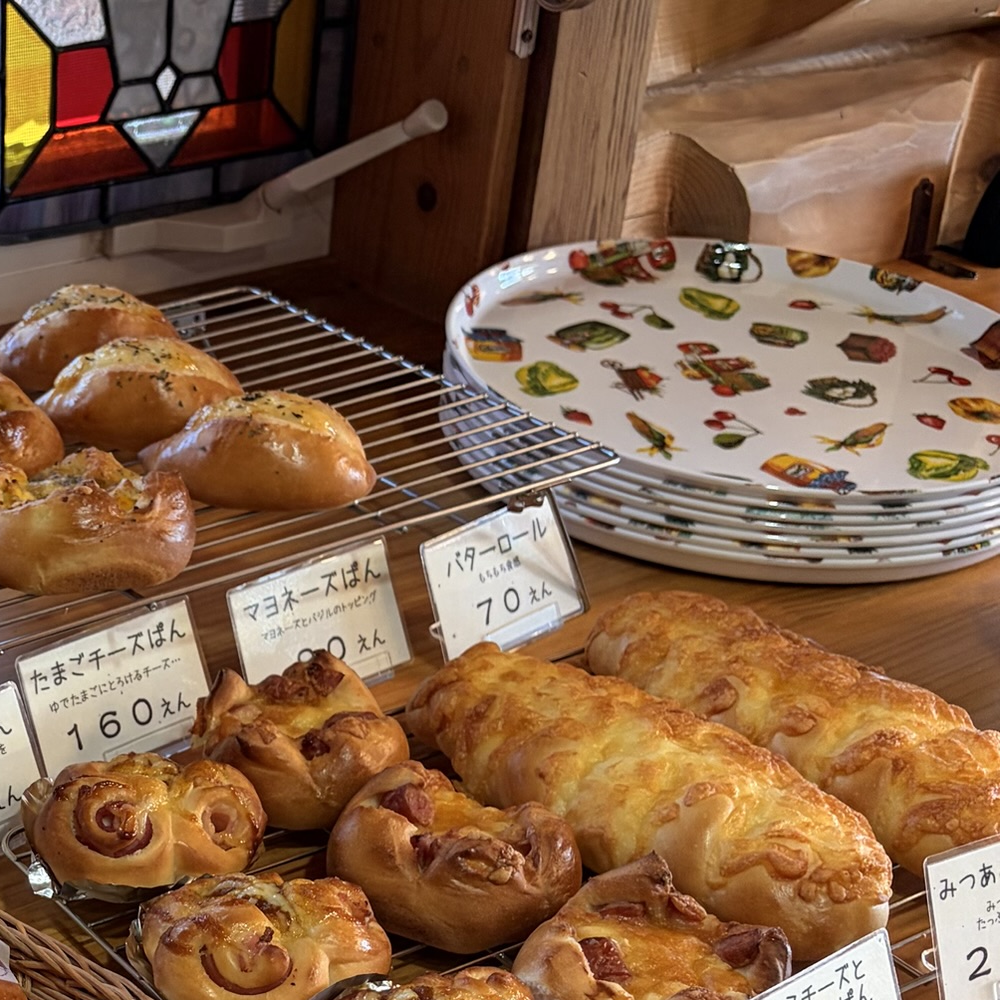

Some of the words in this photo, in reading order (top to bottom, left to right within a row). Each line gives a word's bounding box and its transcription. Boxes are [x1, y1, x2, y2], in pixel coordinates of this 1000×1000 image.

[447, 518, 547, 577] バターロール
[243, 558, 381, 621] マヨネーズぱん
[30, 618, 186, 694] たまごチーズぱん
[67, 692, 191, 751] 160えん
